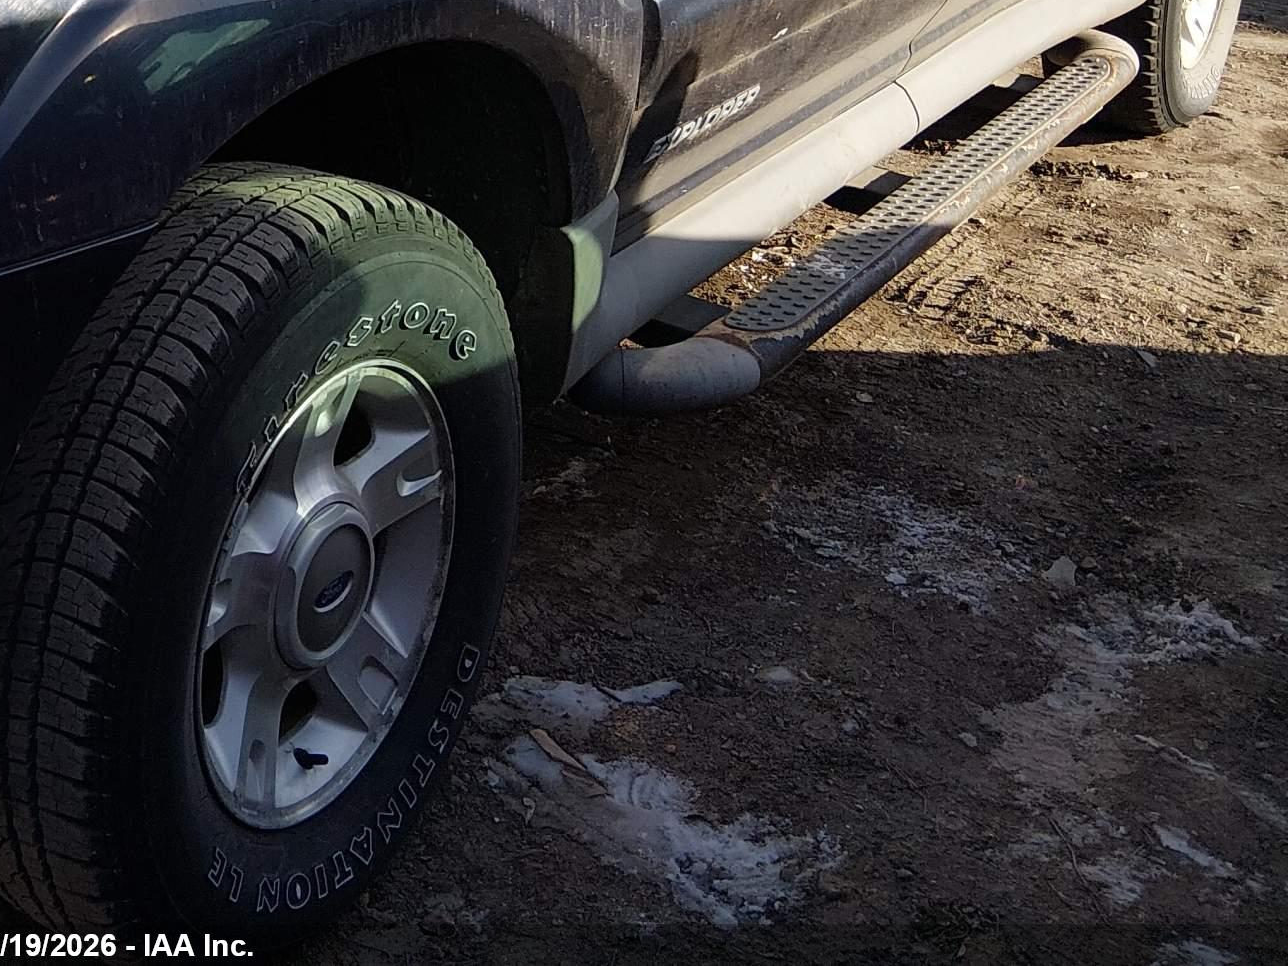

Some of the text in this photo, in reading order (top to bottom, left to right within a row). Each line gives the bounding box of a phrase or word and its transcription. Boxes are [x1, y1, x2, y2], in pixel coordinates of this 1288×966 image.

[643, 83, 761, 164] EXPLORER
[208, 643, 481, 913] DESTINATION LE
